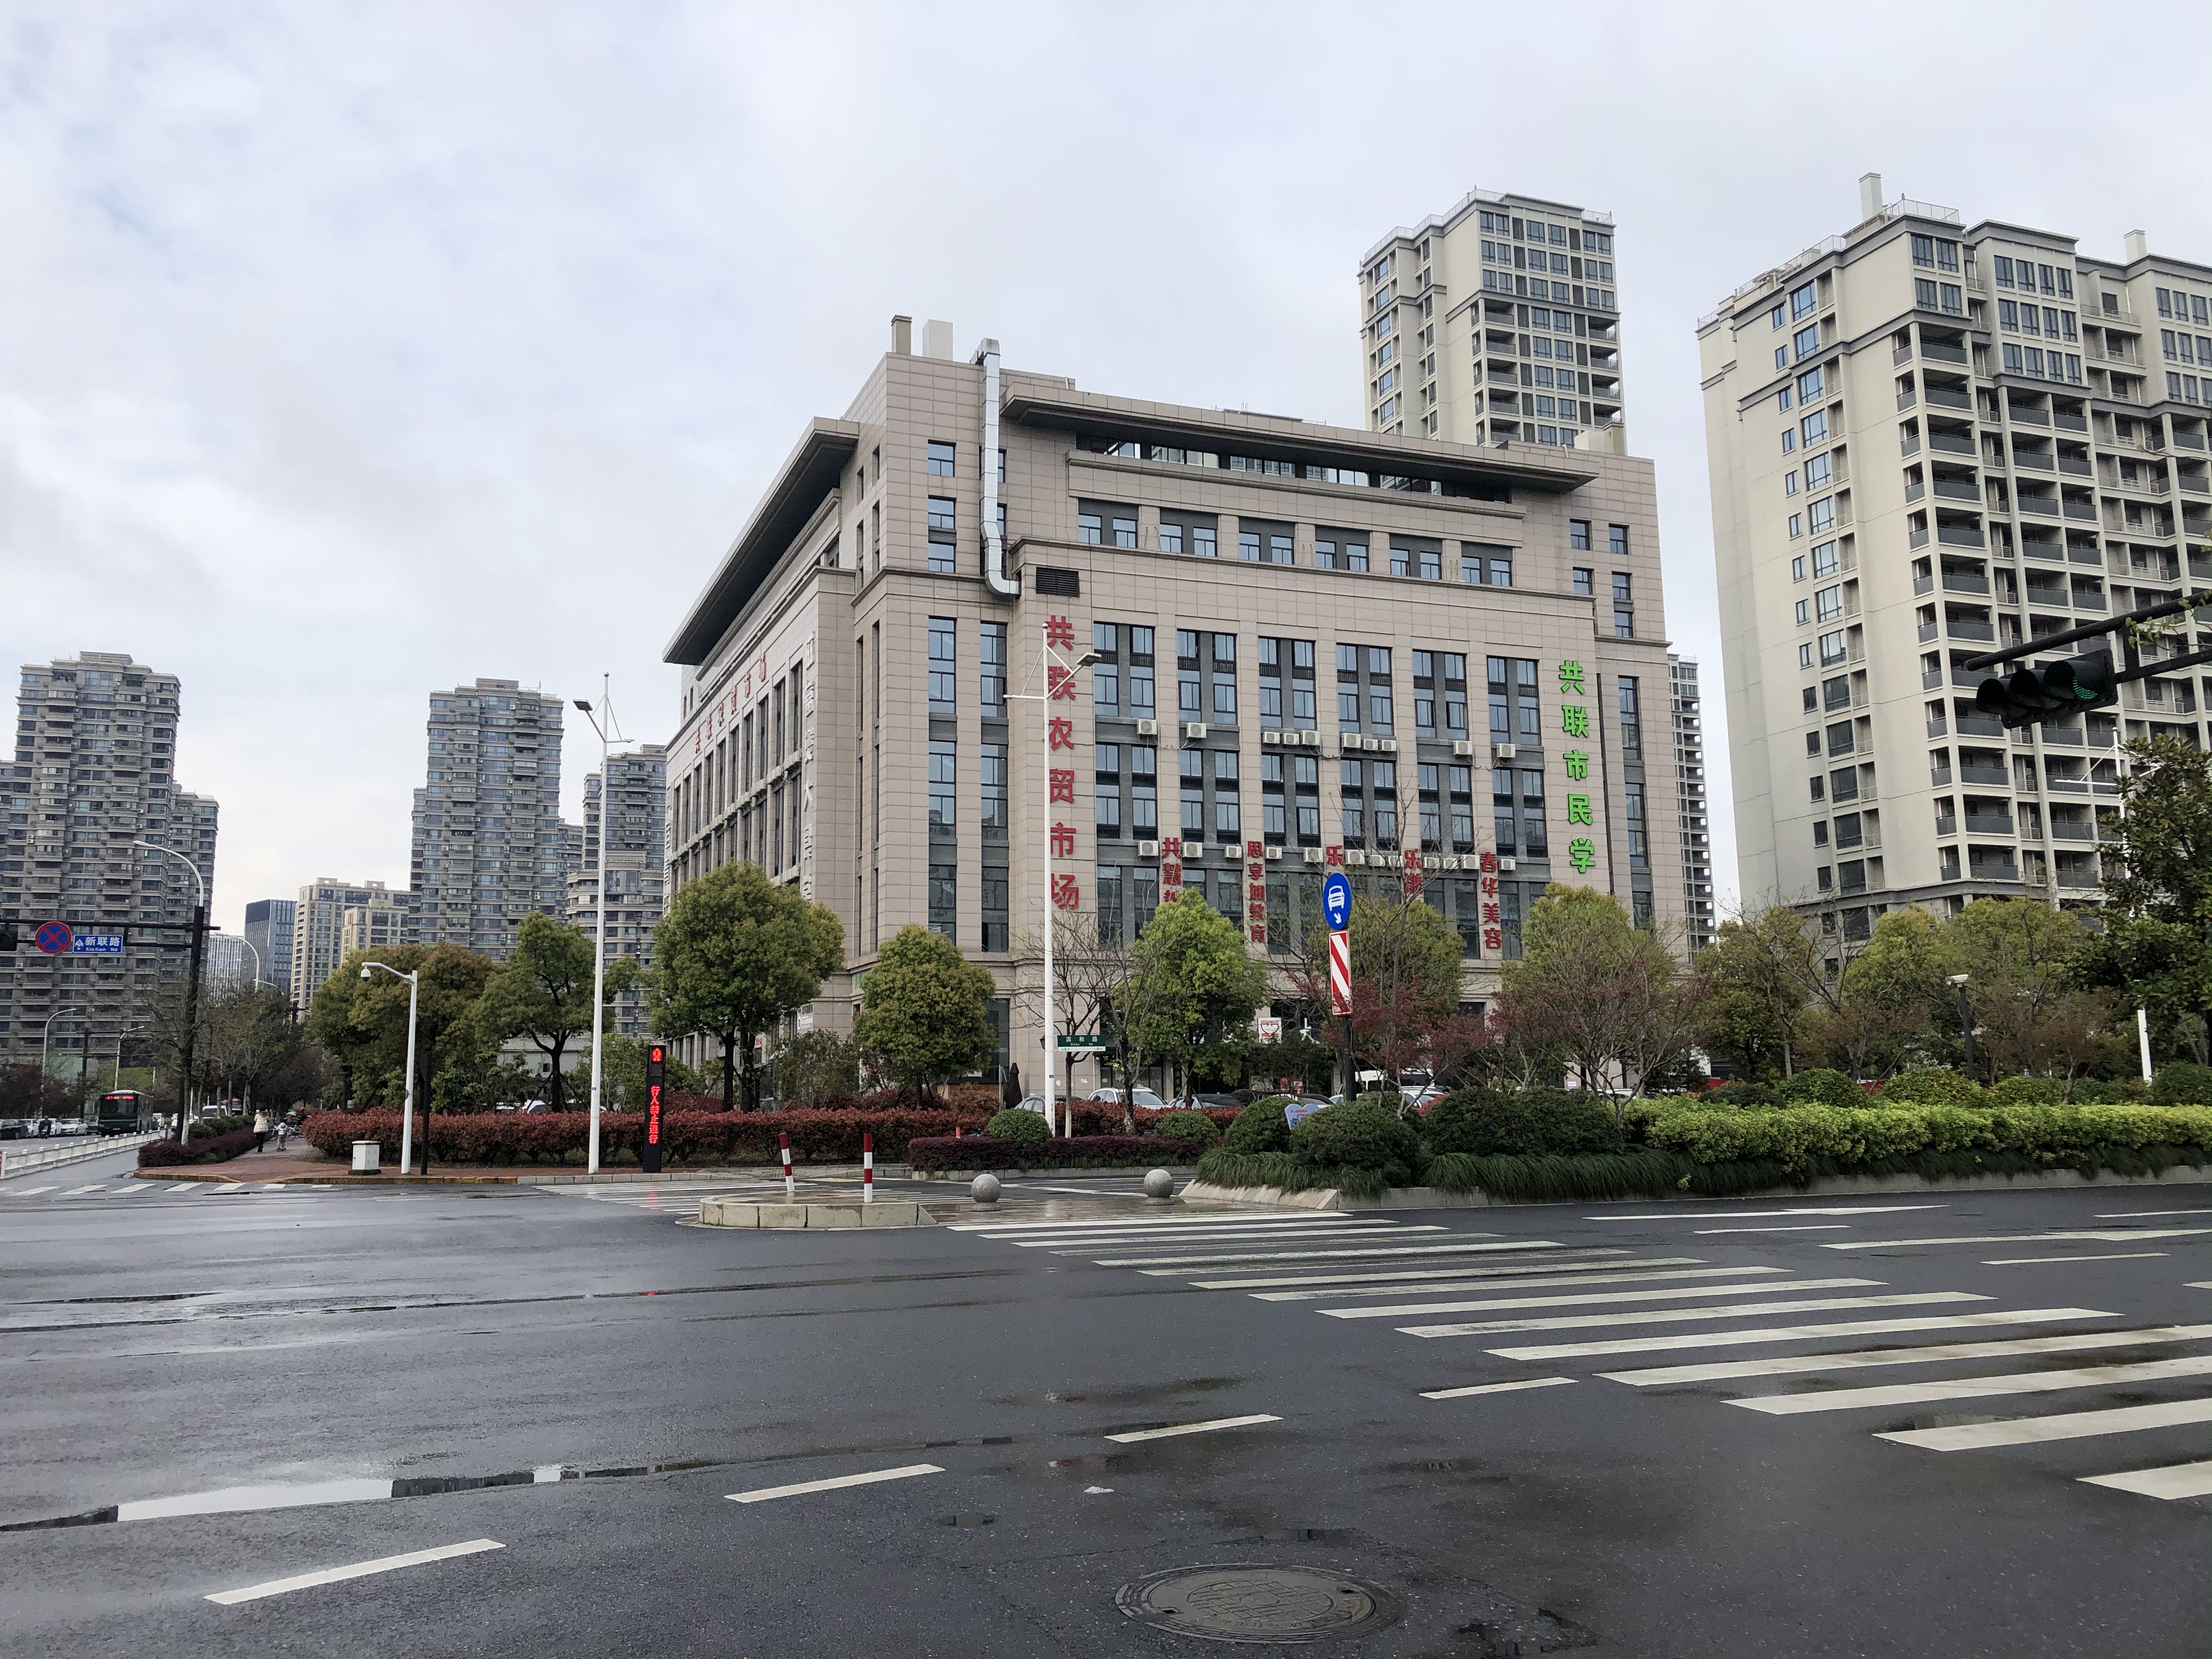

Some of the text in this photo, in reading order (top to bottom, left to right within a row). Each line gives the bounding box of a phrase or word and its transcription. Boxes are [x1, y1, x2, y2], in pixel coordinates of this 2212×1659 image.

[1045, 614, 1079, 910] 共联农贸市场
[1559, 659, 1596, 873] 共联市民学
[84, 936, 120, 946] 新联路
[1480, 851, 1502, 950] 春华美容
[648, 1085, 661, 1144] 行人禁止通行
